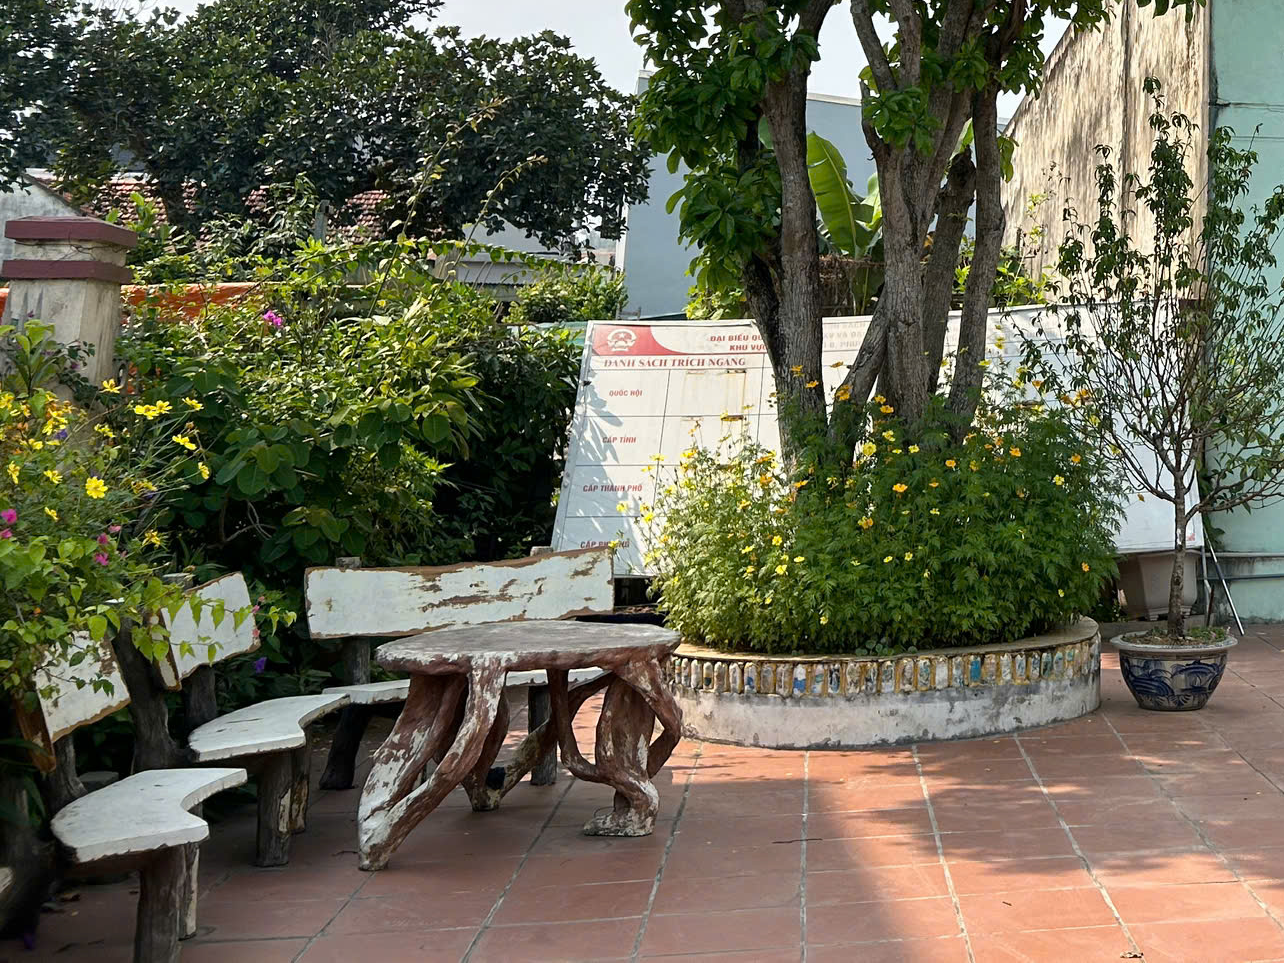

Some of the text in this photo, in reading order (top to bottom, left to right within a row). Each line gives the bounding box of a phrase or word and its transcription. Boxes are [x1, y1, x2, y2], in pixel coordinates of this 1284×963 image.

[604, 359, 635, 367] DANH
[671, 357, 705, 367] TRÍCH
[708, 357, 746, 367] NGANG
